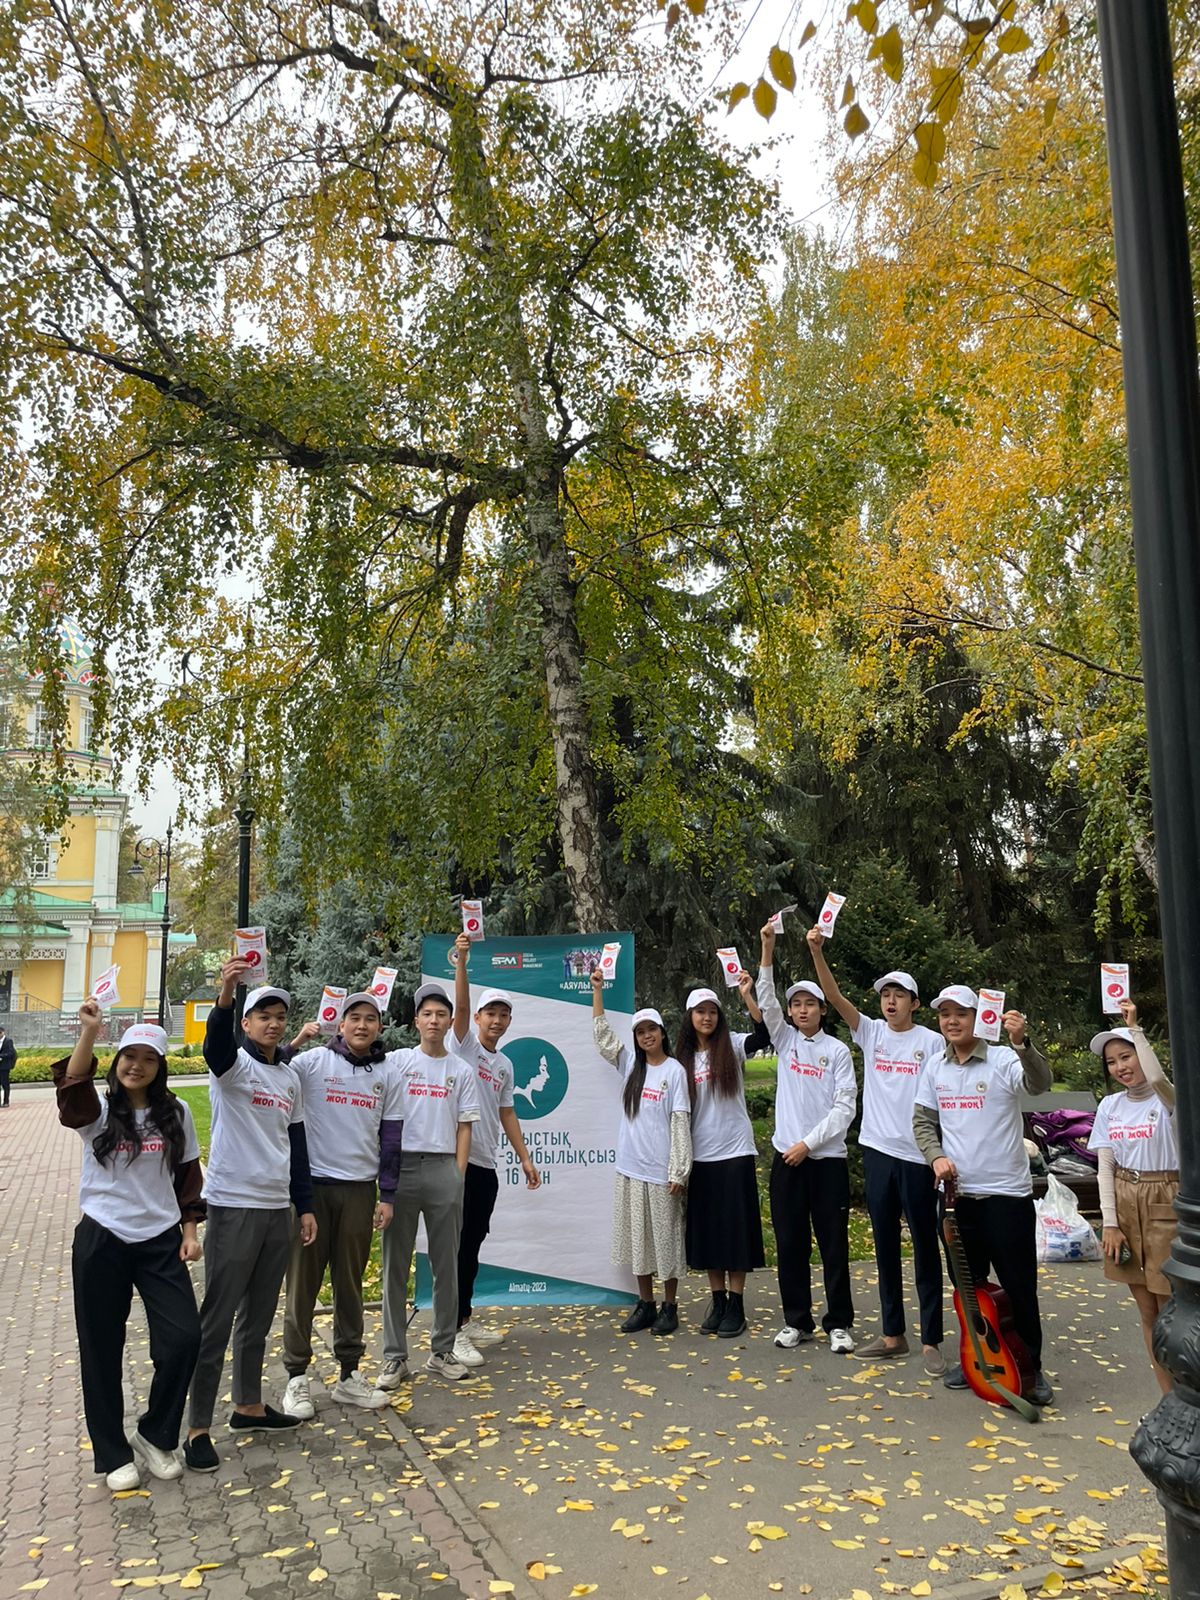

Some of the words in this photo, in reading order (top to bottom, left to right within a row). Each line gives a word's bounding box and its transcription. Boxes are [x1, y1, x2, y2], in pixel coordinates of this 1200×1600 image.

[491, 956, 517, 965] SPM
[505, 1168, 519, 1185] 16
[508, 1282, 547, 1293] Almaty-2023
